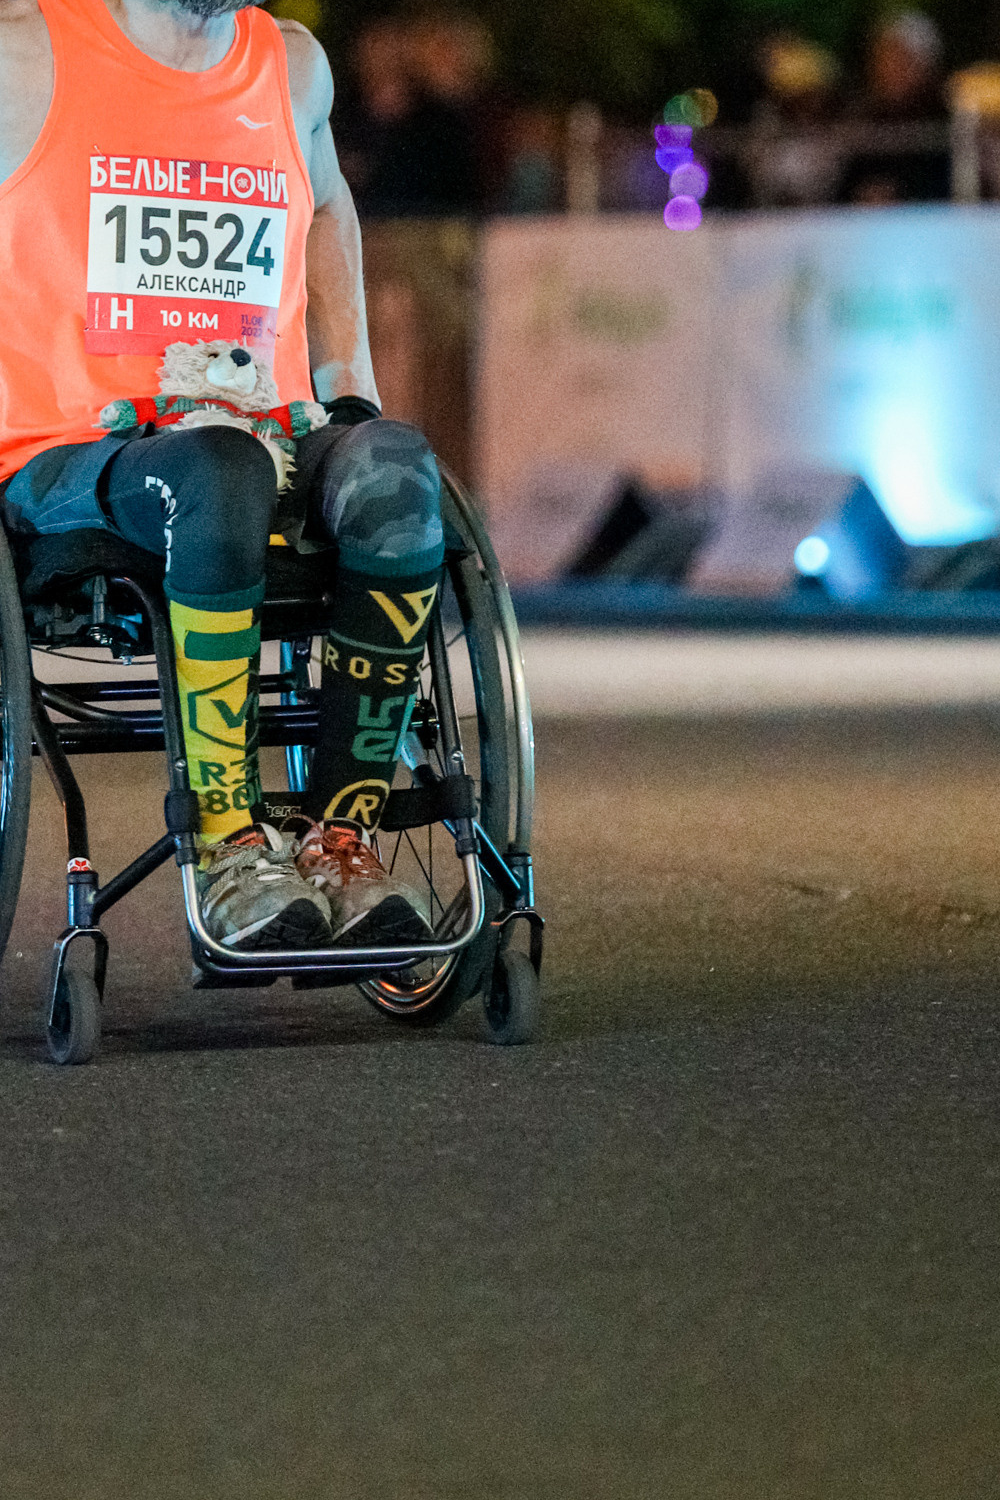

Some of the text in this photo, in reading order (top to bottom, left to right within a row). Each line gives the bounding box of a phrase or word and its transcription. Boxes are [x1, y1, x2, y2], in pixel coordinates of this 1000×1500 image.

[89, 156, 289, 204] БЕЛЫЕ НОЧИ
[104, 204, 275, 276] 15524
[136, 273, 246, 299] АЛЕКСАНДР
[160, 310, 182, 327] 10
